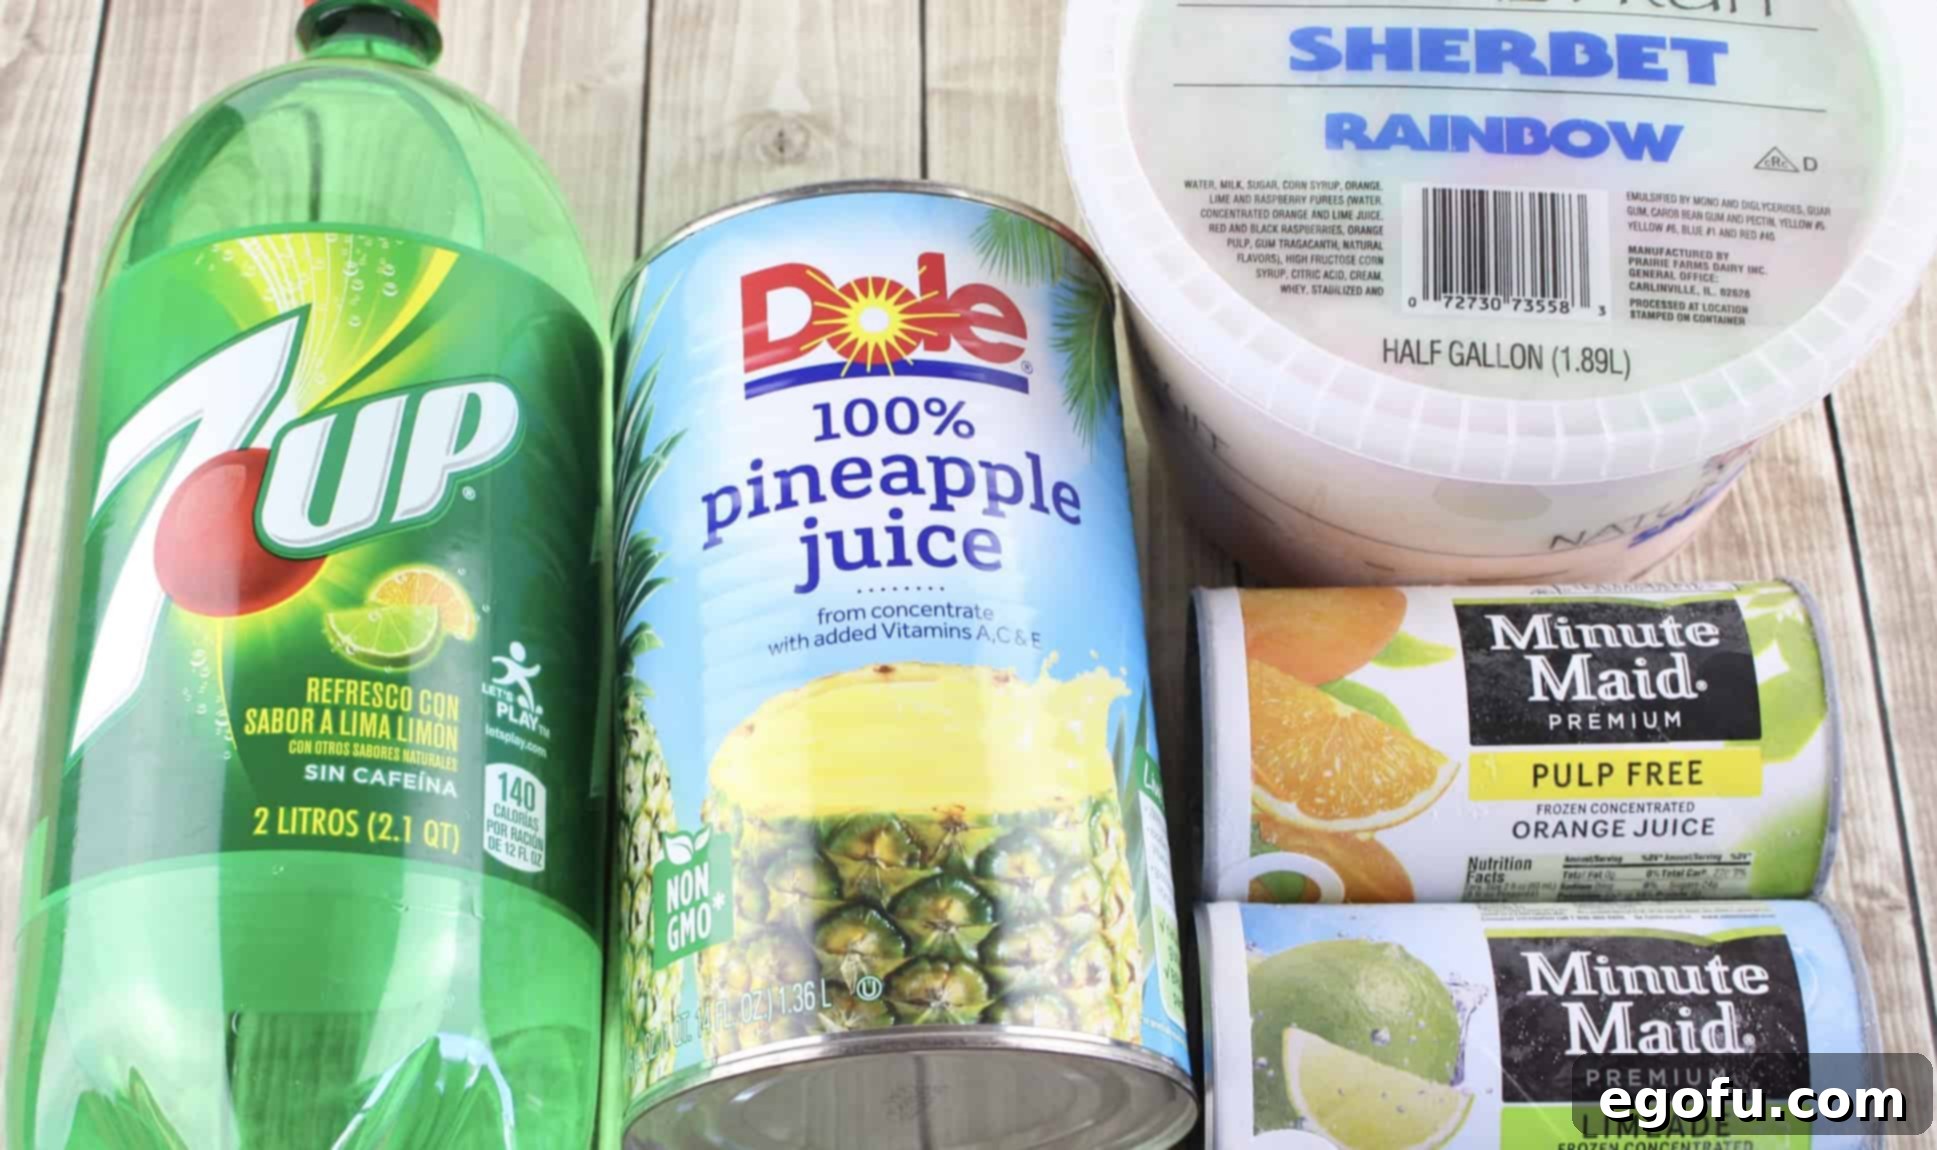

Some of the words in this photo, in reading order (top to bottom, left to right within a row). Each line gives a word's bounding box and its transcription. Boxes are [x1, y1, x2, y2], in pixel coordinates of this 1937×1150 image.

[1289, 27, 1729, 86] SHERBET
[1325, 112, 1684, 163] RAINBOW
[1803, 156, 1818, 171] D
[1184, 180, 1217, 191] WATER,
[1220, 180, 1245, 191] MILK,
[1282, 180, 1307, 191] CORN
[1209, 194, 1230, 204] LIME
[1233, 194, 1252, 205] AND
[1254, 194, 1307, 205] RASPBERRY
[1310, 195, 1345, 206] PUREES
[1626, 191, 1677, 204] EMULSIFIED
[1679, 195, 1690, 205] BY
[1693, 196, 1719, 207] MONO
[1721, 198, 1739, 209] AND
[1806, 206, 1831, 217] GUAR
[1200, 208, 1270, 219] CONCENTRATED
[1272, 209, 1308, 220] ORANGE
[1311, 210, 1330, 220] AND
[1332, 210, 1353, 221] LIME
[1650, 207, 1680, 219] CAROB
[1681, 209, 1703, 220] BEAN
[1705, 211, 1724, 222] GUM
[1726, 213, 1744, 225] AND
[1779, 217, 1812, 231] YELLOW
[1208, 223, 1227, 233] RED
[1228, 223, 1248, 234] AND
[1250, 224, 1278, 234] BLACK
[1281, 224, 1345, 236] RASPBERRIES,
[1347, 225, 1384, 236] ORANGE
[1628, 221, 1663, 233] YELLOW
[1681, 225, 1703, 236] BLUE
[1706, 227, 1716, 236] #1
[1719, 228, 1737, 239] AND
[1740, 229, 1757, 240] RED
[1255, 239, 1276, 249] GUM
[1279, 239, 1341, 251] TRAGACANTH,
[1343, 240, 1383, 251] NATURAL
[1628, 246, 1713, 260] MANUFACTURED
[1716, 251, 1729, 261] BY
[1286, 254, 1308, 265] HIGH
[1311, 255, 1356, 265] FRUCTOSE
[1359, 255, 1384, 266] CORN
[1628, 257, 1670, 269] PRAIRIE
[1673, 260, 1709, 271] FARMS
[1713, 262, 1744, 274] DAIRY
[1291, 269, 1321, 280] CITRIC
[1629, 268, 1675, 280] GENERAL
[1311, 285, 1362, 296] STABILIZED
[1366, 286, 1384, 297] AND
[1629, 282, 1700, 296] CARLINVILLE,
[741, 251, 1028, 374] Dole
[1408, 297, 1417, 308] 0
[1443, 295, 1501, 312] 72730
[1512, 298, 1570, 315] 73558
[1598, 305, 1606, 317] 3
[1630, 298, 1686, 311] PROCESSED
[1688, 302, 1699, 311] AT
[1702, 303, 1748, 314] LOCATION
[1630, 310, 1674, 322] STAMPED
[1677, 313, 1690, 322] ON
[1693, 313, 1746, 326] CONTAINER
[1383, 338, 1442, 365] HALF
[1449, 340, 1543, 371] GALLON
[1552, 345, 1631, 381] (1.89L)
[812, 396, 976, 443] 100%
[701, 450, 1082, 551] pineapple
[793, 507, 1002, 594] juice
[817, 607, 867, 625] from
[871, 602, 994, 622] concentrate
[768, 633, 810, 656] with
[813, 623, 878, 648] added
[880, 621, 973, 641] Vitamins
[1031, 632, 1043, 650] E
[1485, 613, 1719, 651] Minute
[1523, 652, 1699, 702] Maid
[306, 676, 413, 712] REFRESCO
[419, 688, 459, 721] CON
[481, 682, 514, 702] LET'S
[244, 707, 315, 735] SABOR
[320, 708, 333, 735] A
[340, 709, 391, 740] LIMA
[1549, 711, 1682, 731] PREMIUM
[484, 723, 548, 759] letsplay.com
[288, 739, 312, 755] CON
[315, 740, 350, 757] OTROS
[352, 743, 400, 762] SABORES
[402, 749, 459, 773] NATURALES
[304, 763, 346, 781] SIN
[352, 767, 459, 798] CAFEÍNA
[1532, 763, 1614, 788] PULP
[1627, 760, 1704, 786] FREE
[497, 771, 536, 813] 140
[1536, 803, 1587, 816] FROZEN
[1590, 801, 1695, 815] CONCENTRATED
[253, 806, 269, 835] 2
[277, 806, 359, 838] LITROS
[367, 811, 413, 844] (2.1
[423, 818, 461, 855] QT)
[486, 819, 508, 838] POR
[1512, 819, 1626, 840] ORANGE
[1633, 817, 1716, 838] JUICE
[487, 836, 502, 850] DE
[504, 840, 517, 856] 12
[517, 845, 529, 863] FL
[530, 852, 542, 868] OZ
[1468, 856, 1533, 872] Nutrition
[1662, 868, 1685, 878] Total
[666, 862, 709, 914] NON
[1466, 872, 1505, 884] Facts
[1521, 951, 1769, 997] Minute
[779, 980, 816, 1015] 1.36
[820, 978, 832, 1008] L
[1562, 1001, 1743, 1055] Maid
[1582, 1113, 1732, 1139] LIMADE
